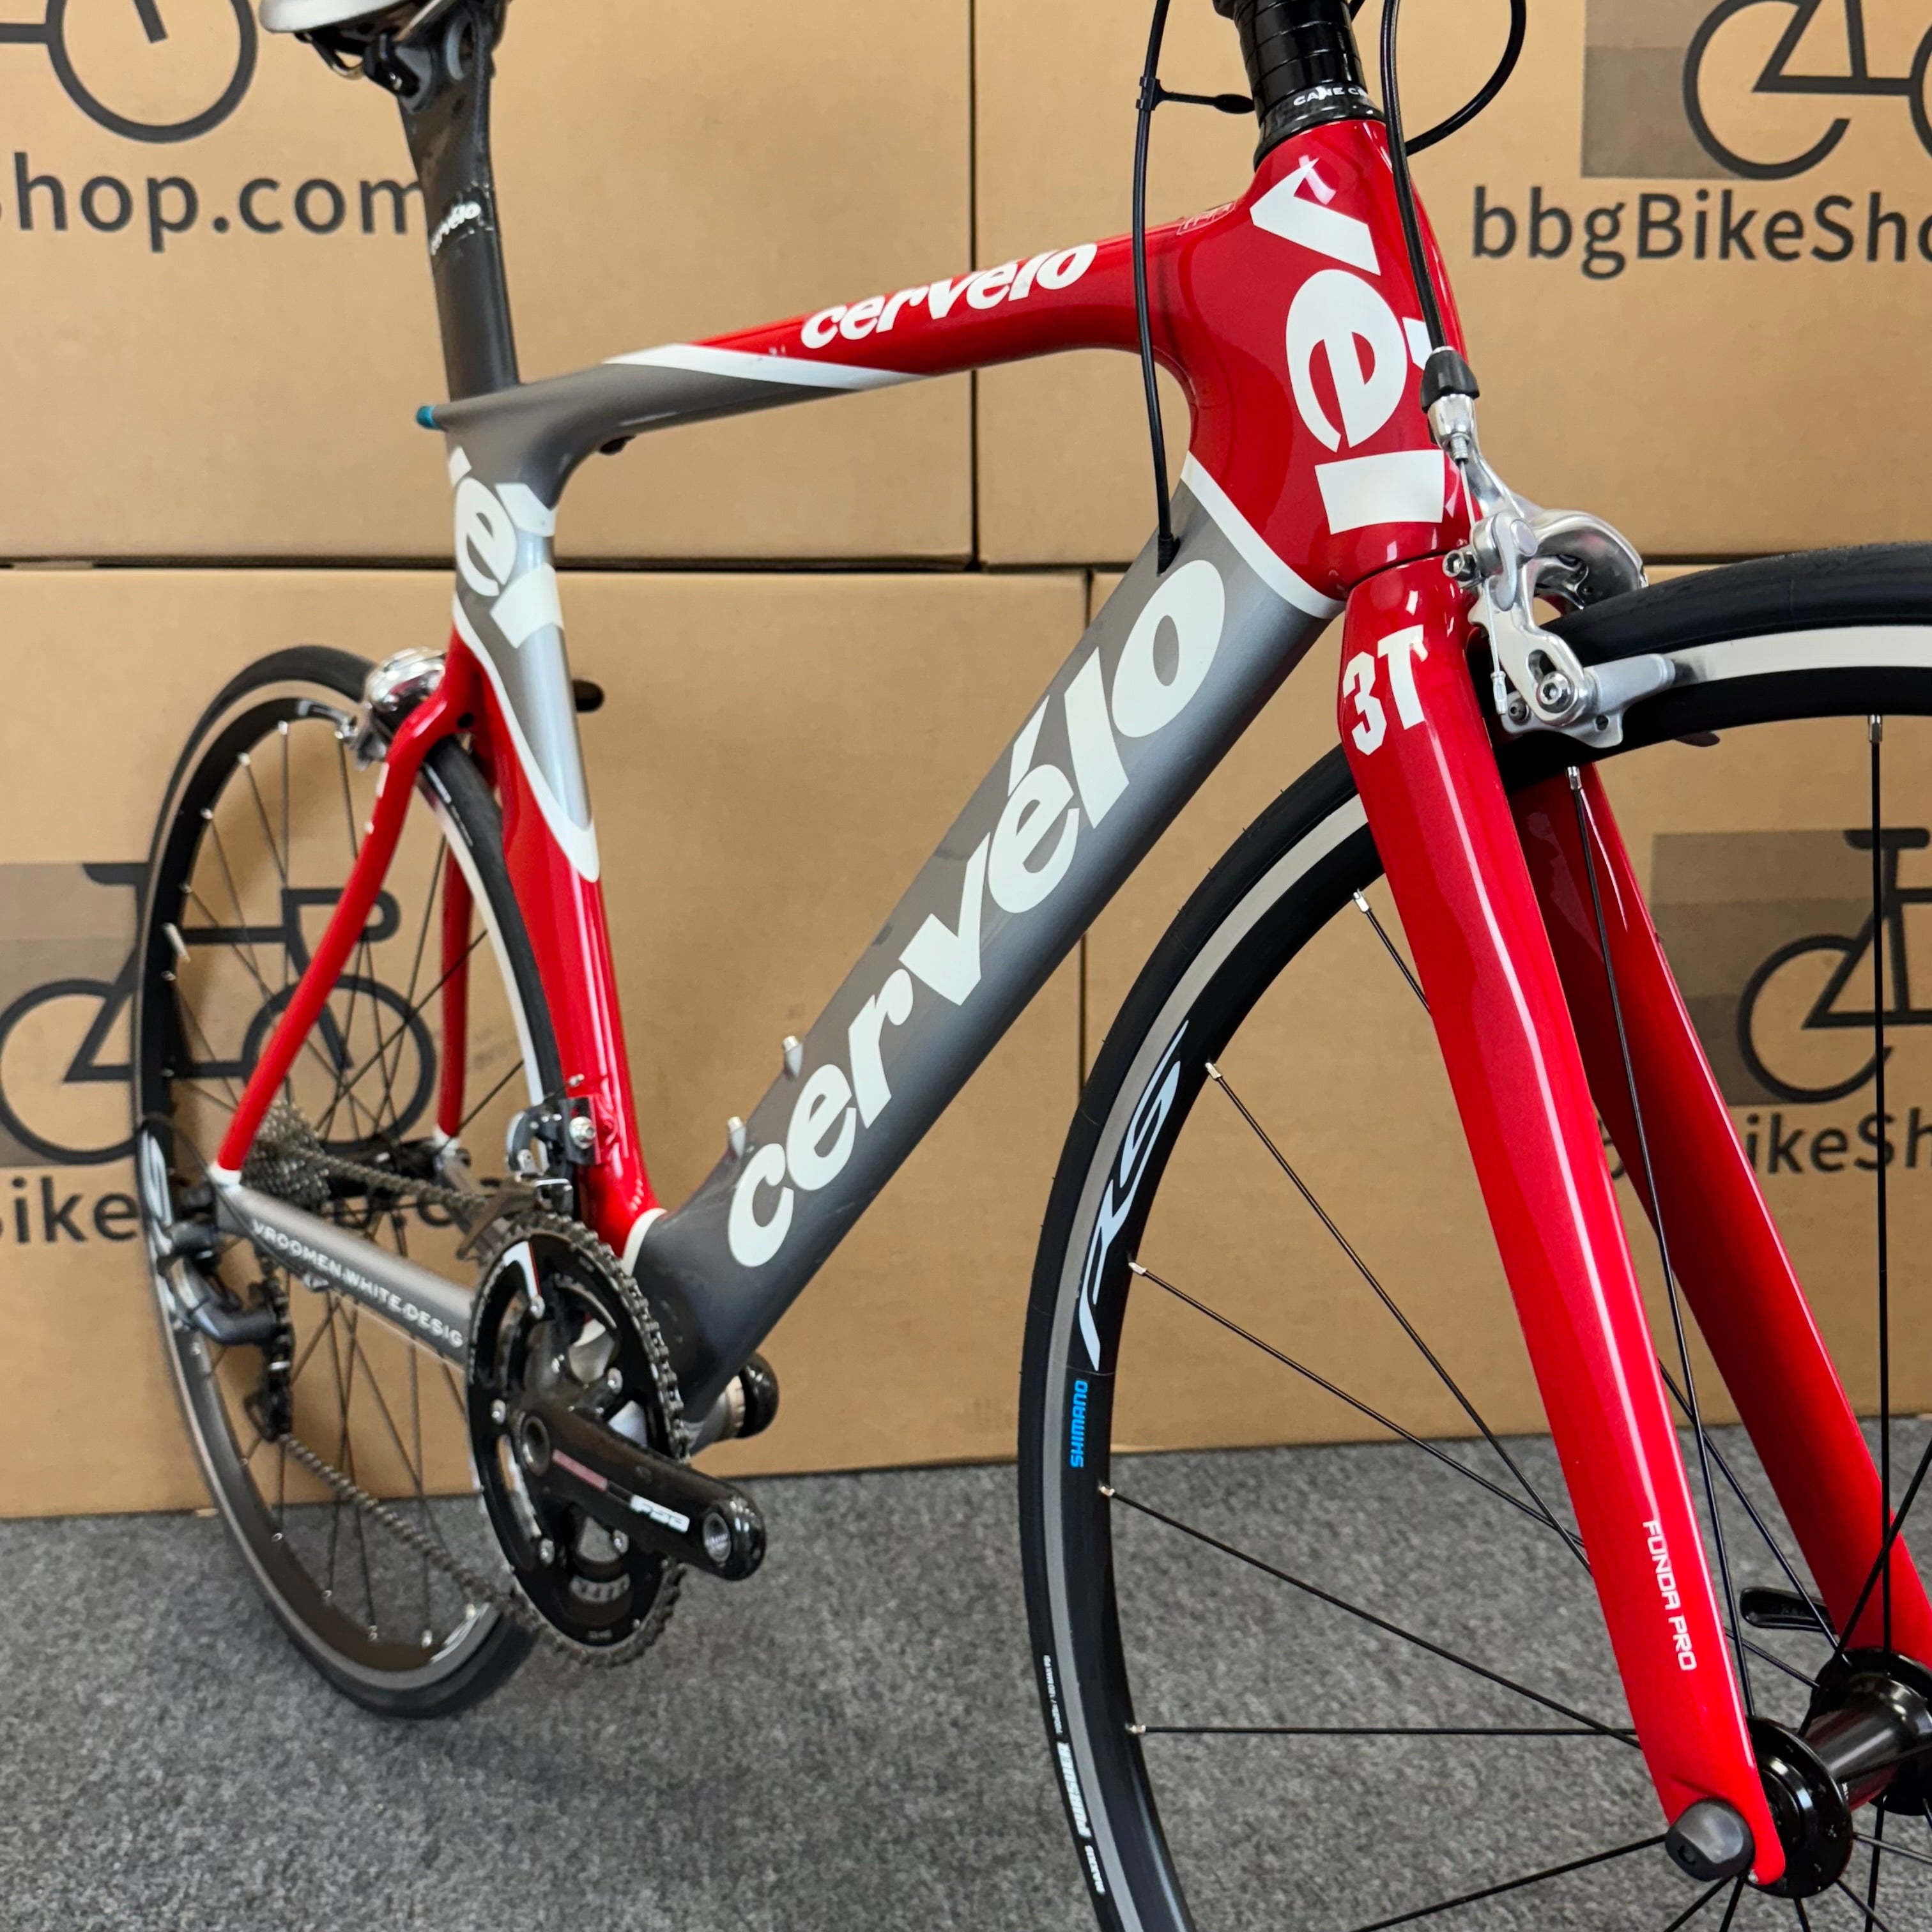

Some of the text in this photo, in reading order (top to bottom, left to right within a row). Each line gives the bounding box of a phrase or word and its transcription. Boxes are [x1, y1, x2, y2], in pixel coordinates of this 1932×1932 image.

[1293, 87, 1345, 106] CANE
[0, 151, 422, 254] hop.com
[1342, 624, 1428, 756] 3T
[727, 558, 1226, 1268] cervélo
[0, 1176, 140, 1243] ike
[252, 1218, 464, 1336] VROOMEN.WHITE.DESIG
[1070, 1379, 1089, 1468] SHIMANO
[1643, 1519, 1697, 1671] FUNDA PRO
[1056, 1742, 1092, 1839] PURSUER
